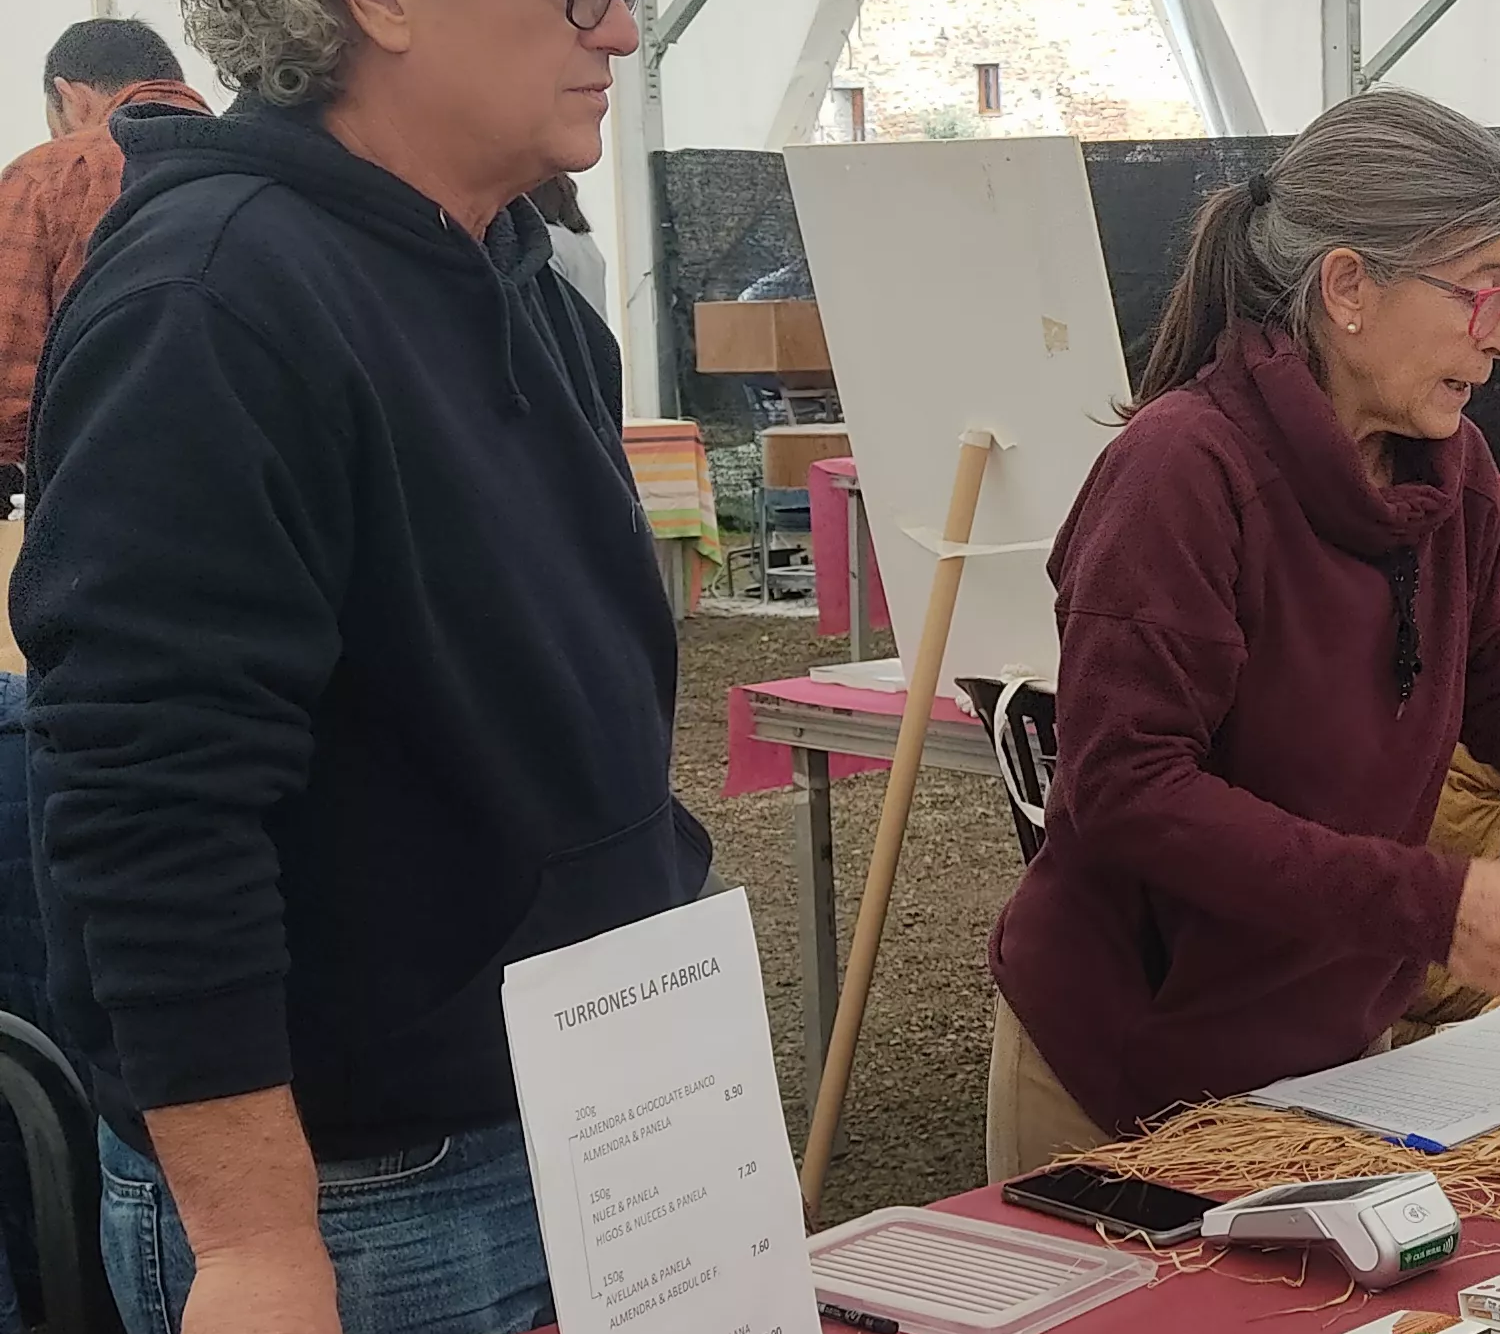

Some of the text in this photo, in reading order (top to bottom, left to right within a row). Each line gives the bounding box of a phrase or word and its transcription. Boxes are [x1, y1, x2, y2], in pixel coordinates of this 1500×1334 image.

[554, 957, 720, 1031] TURRONES LA FABRICA
[579, 1074, 715, 1140] ALMENDRA & CHOCOLATE BLANCO
[724, 1083, 743, 1101] 8.90
[575, 1105, 596, 1121] 200g
[583, 1116, 672, 1163] ALMENDRA & PANELA
[738, 1161, 757, 1179] 7.20
[590, 1187, 611, 1204] 150g
[592, 1186, 659, 1224] NUEZ & PANELA
[595, 1187, 708, 1246] HIGOS & NUECES & PANELA
[751, 1238, 770, 1257] 7.60
[603, 1269, 624, 1288] 150g
[606, 1257, 692, 1307] AVELLANA & PANELA
[610, 1297, 657, 1330] ALMENDRA
[659, 1293, 666, 1304] &
[667, 1276, 699, 1301] ABEDUL
[700, 1269, 711, 1284] DE
